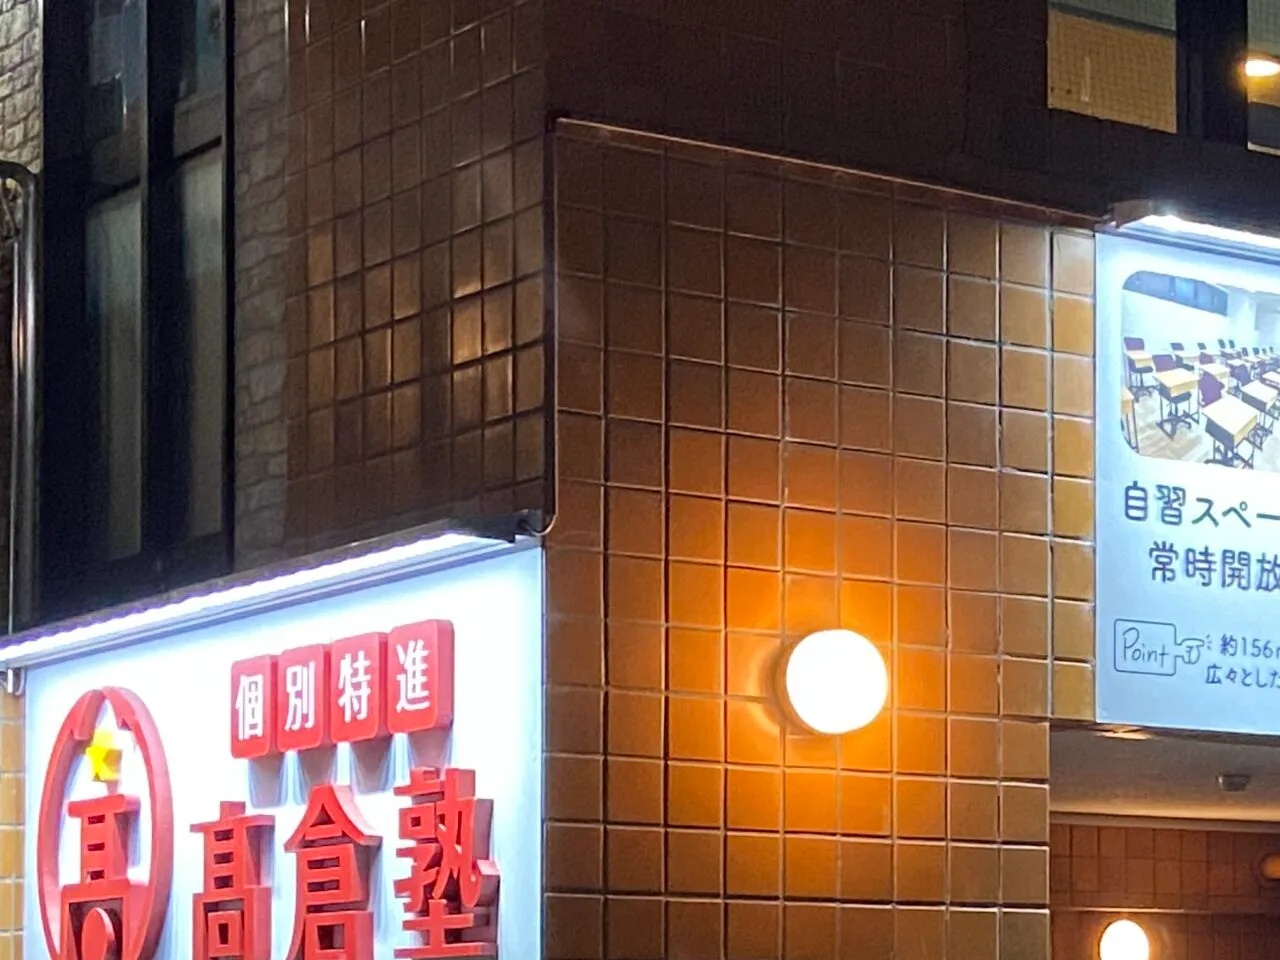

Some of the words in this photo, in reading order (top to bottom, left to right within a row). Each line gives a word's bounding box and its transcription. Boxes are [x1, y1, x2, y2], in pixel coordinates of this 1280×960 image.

[1122, 627, 1170, 668] Point
[235, 640, 431, 741] 個別特進
